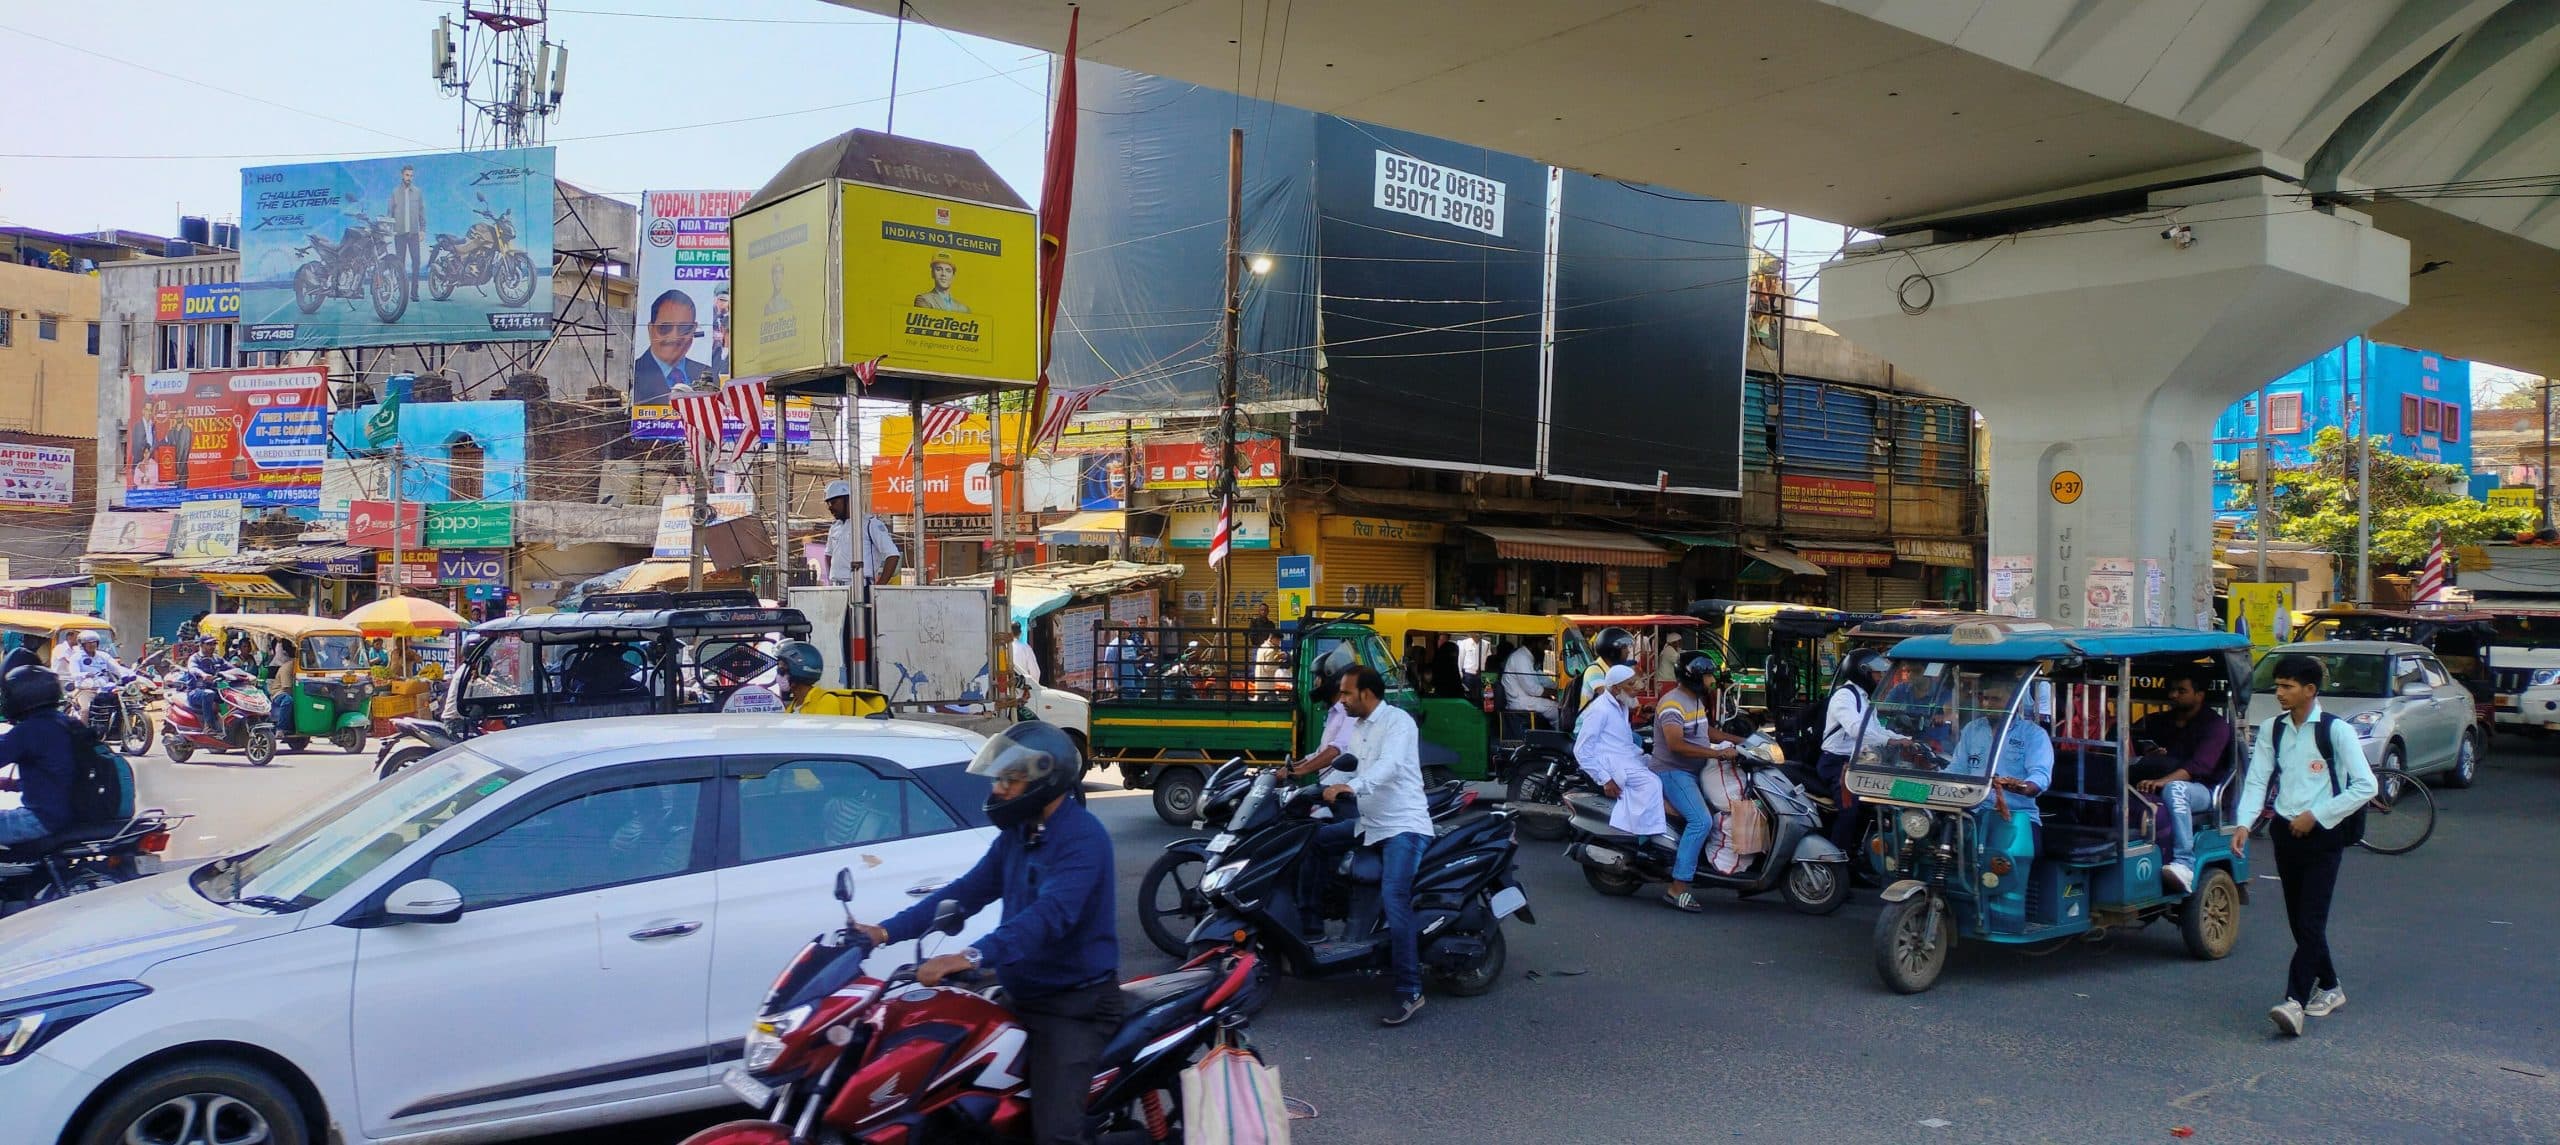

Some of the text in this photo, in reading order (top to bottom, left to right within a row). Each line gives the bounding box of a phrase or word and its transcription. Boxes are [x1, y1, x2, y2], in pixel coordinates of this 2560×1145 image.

[869, 158, 939, 185] Traffic
[257, 173, 284, 184] Hero
[1385, 157, 1496, 206] 95702 08133
[260, 188, 330, 201] CHALLENGE
[256, 196, 341, 210] THE EXTREME
[650, 192, 695, 218] YODDHA
[1384, 183, 1494, 231] 95071 38789
[681, 220, 700, 231] NDA
[679, 237, 698, 247] NDA
[885, 226, 998, 252] INDIA'S NO.1 CEMENT
[678, 251, 696, 262] NDA
[161, 294, 179, 303] DCA
[160, 303, 178, 313] DTP
[185, 297, 216, 314] DUX
[905, 312, 979, 334] UltraTech
[908, 327, 977, 341] CEMENT
[186, 404, 216, 416] TIMES
[169, 415, 233, 434] BSINESS
[38, 452, 71, 463] PLAZA
[888, 475, 949, 493] Xiami
[2054, 482, 2081, 494] P-37
[1212, 503, 1262, 513] MTOR
[2491, 496, 2529, 508] RELAX
[213, 508, 230, 518] SALE
[429, 516, 478, 533] oppo
[1352, 519, 1374, 537] रिया
[1378, 519, 1404, 539] मोटर
[1080, 533, 1110, 543] MOHAN
[379, 553, 437, 562] MOLE.COM
[326, 564, 358, 574] WATCH
[444, 556, 500, 576] vivo
[1288, 567, 1306, 575] MAK
[1211, 591, 1271, 610] AK
[1363, 584, 1408, 608] MAK
[1856, 776, 1890, 790] TERR
[1929, 783, 1969, 798] TORS
